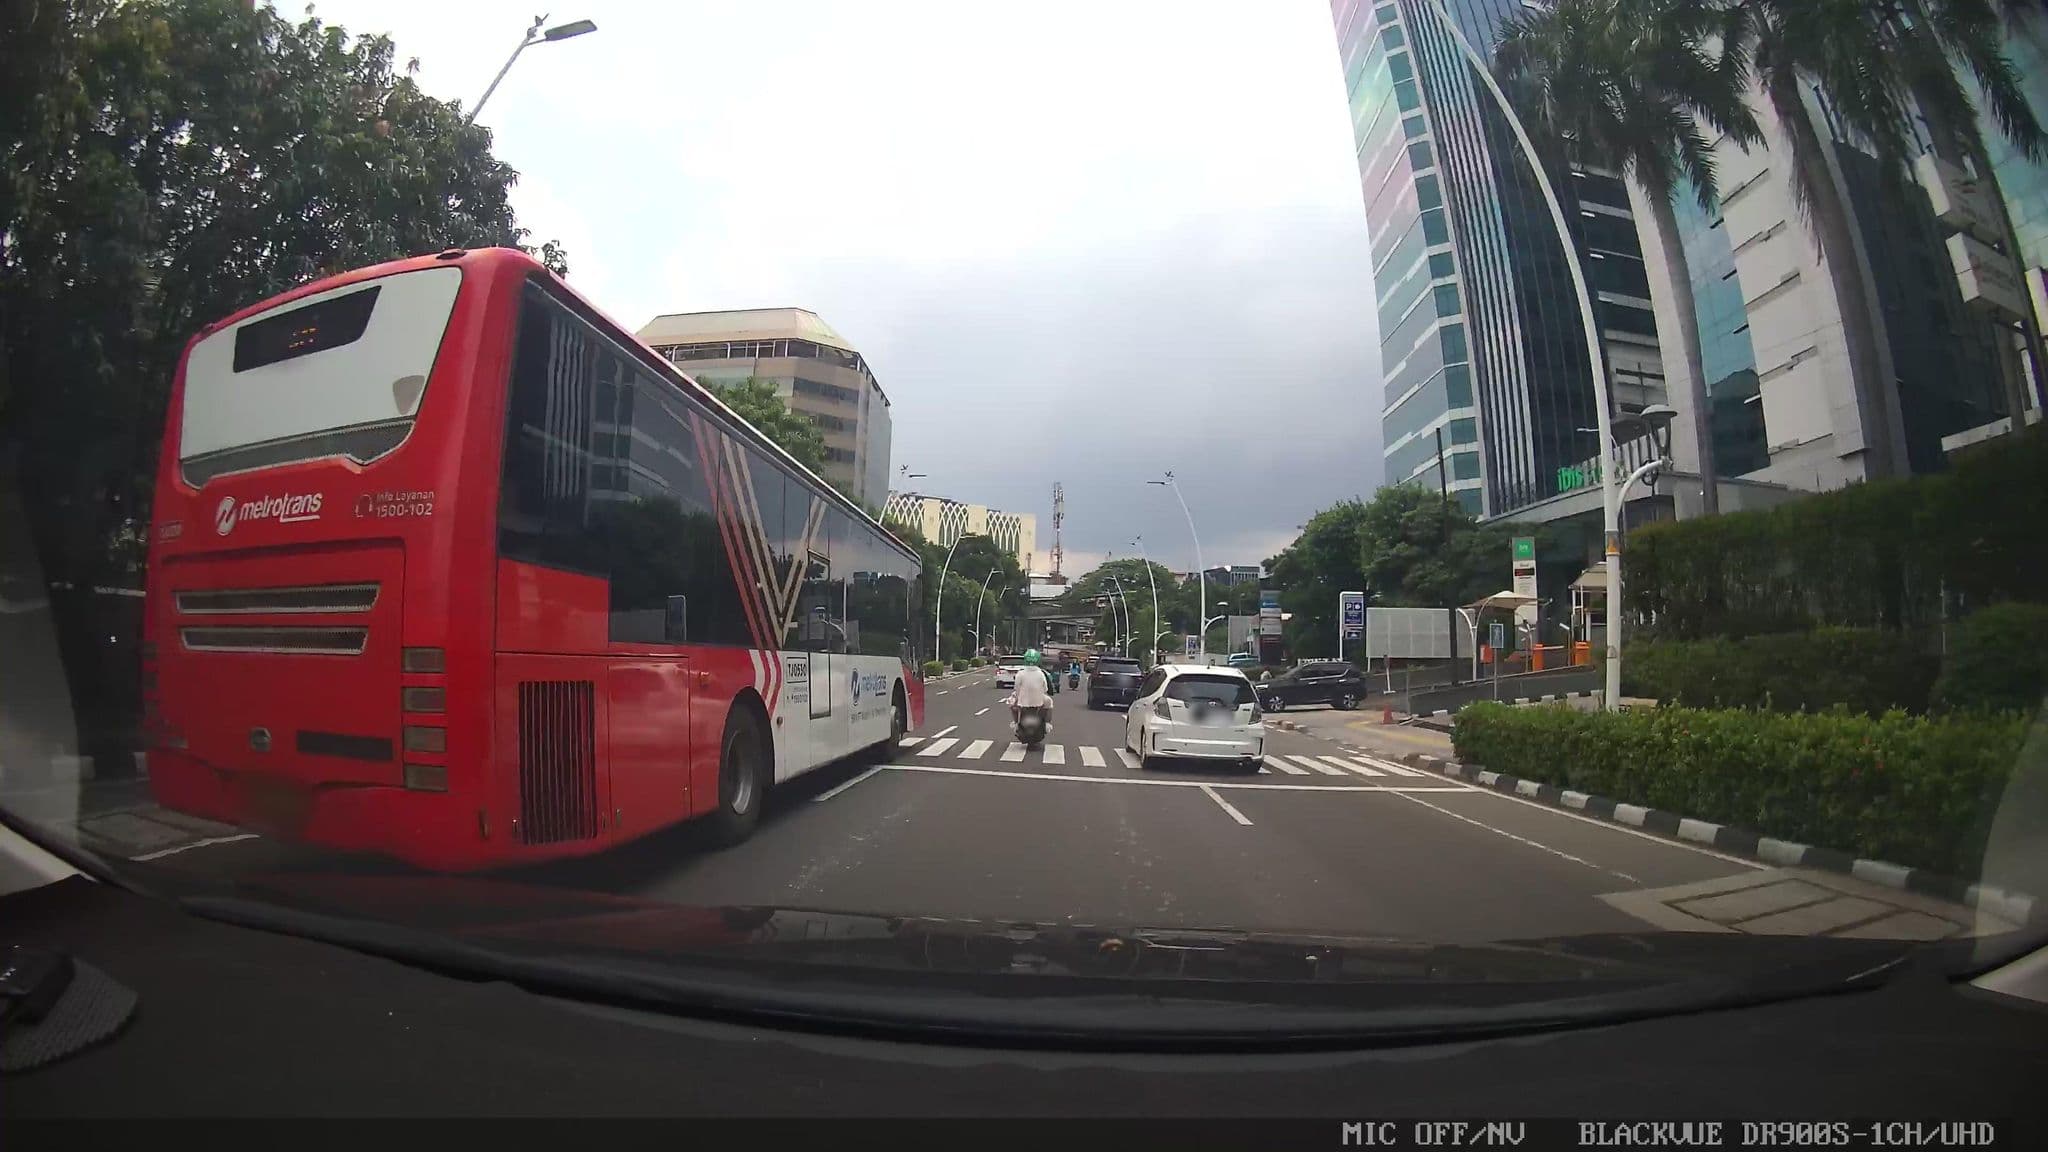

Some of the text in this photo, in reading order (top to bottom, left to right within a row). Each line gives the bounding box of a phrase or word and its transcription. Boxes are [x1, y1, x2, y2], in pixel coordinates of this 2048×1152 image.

[376, 490, 434, 503] Info Layanan
[239, 492, 323, 523] metrotrans
[376, 503, 433, 518] 1500-102
